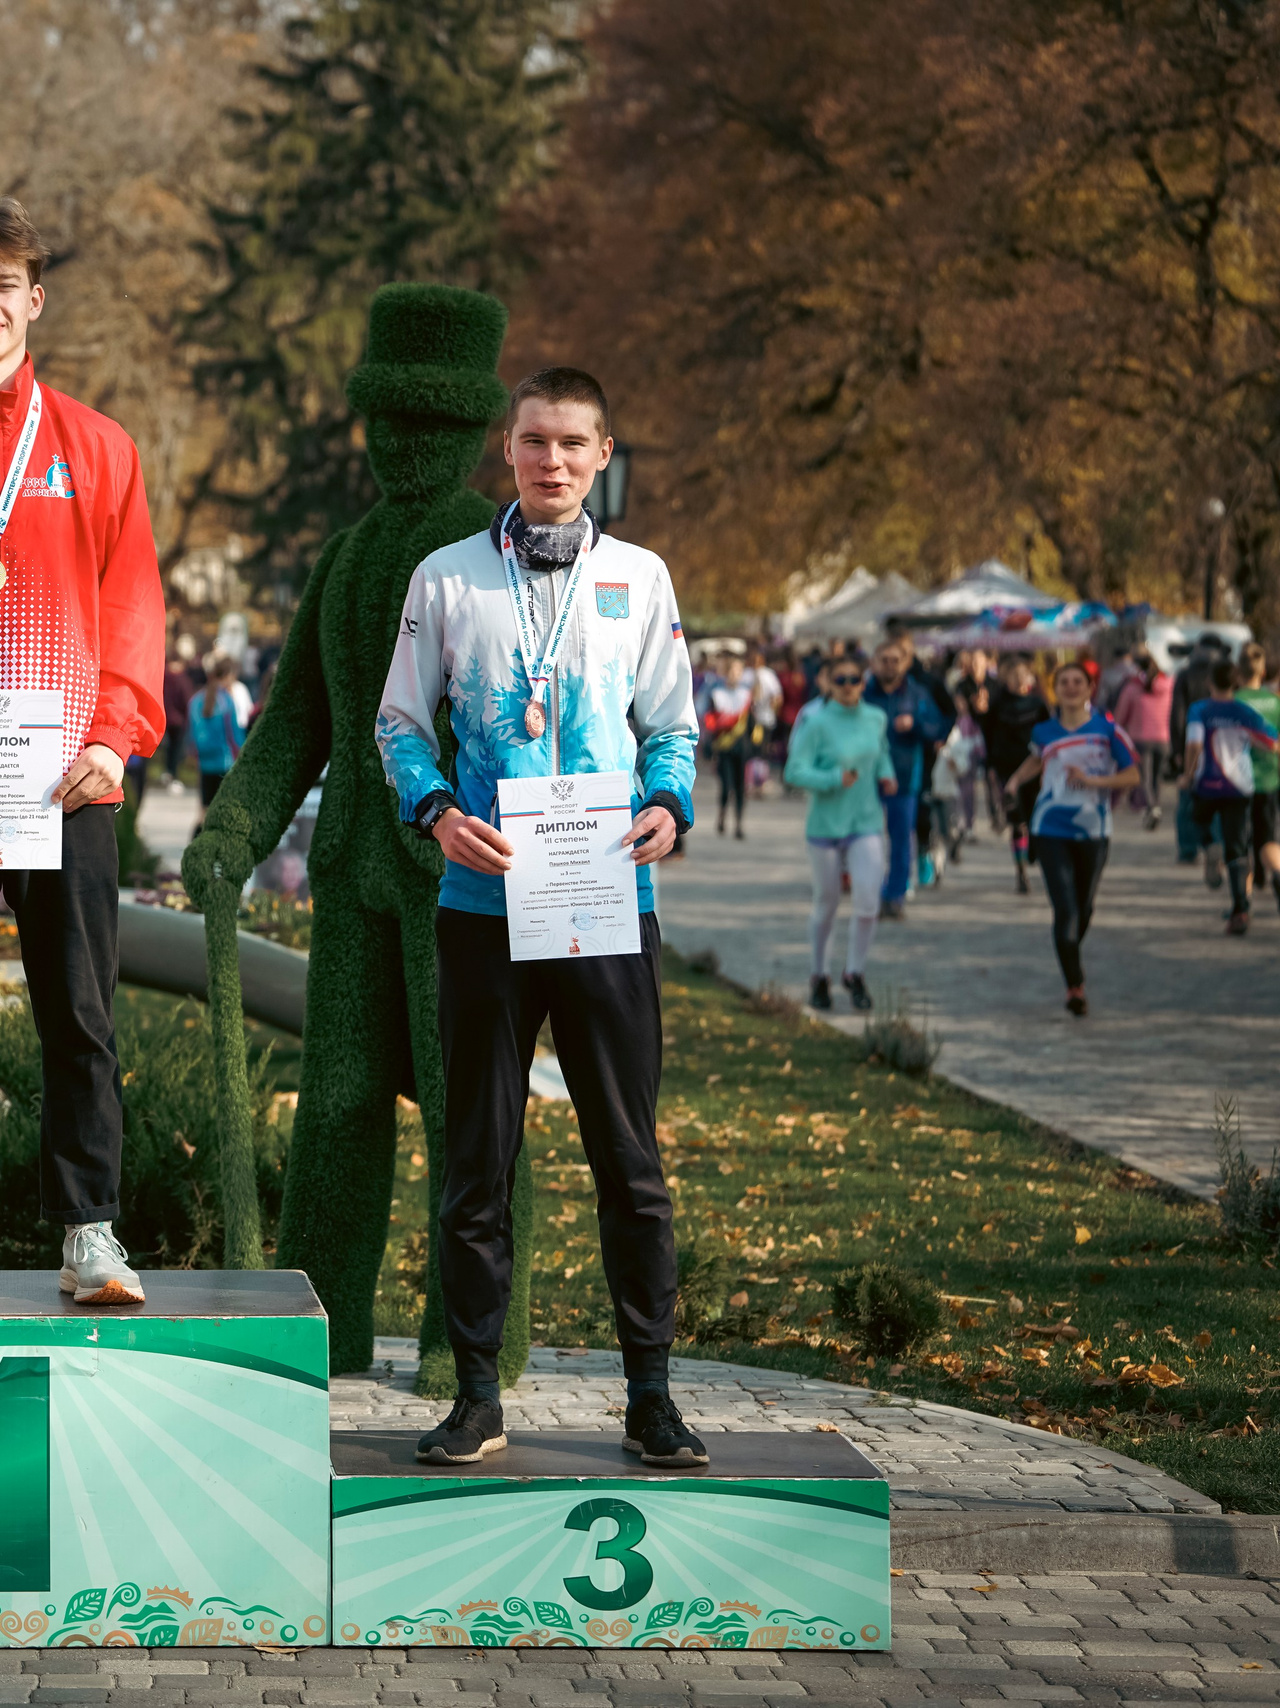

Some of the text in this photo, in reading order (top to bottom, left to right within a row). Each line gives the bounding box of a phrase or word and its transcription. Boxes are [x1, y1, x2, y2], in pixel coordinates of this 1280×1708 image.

[2, 420, 35, 511] МИНИСТЕРСТВО СПОРТА РОССИИ
[22, 489, 58, 497] МОСКВА
[507, 558, 531, 656] МИНИСТЕРСТВО СПОРТА РОССИИ
[526, 576, 535, 624] VICTORY
[550, 610, 568, 657] МИНИСТЕРСТВО
[565, 587, 575, 610] СПОРТА
[535, 820, 598, 835] ДИПЛОМ
[571, 885, 615, 893] ориентированию
[563, 1497, 654, 1612] 3
